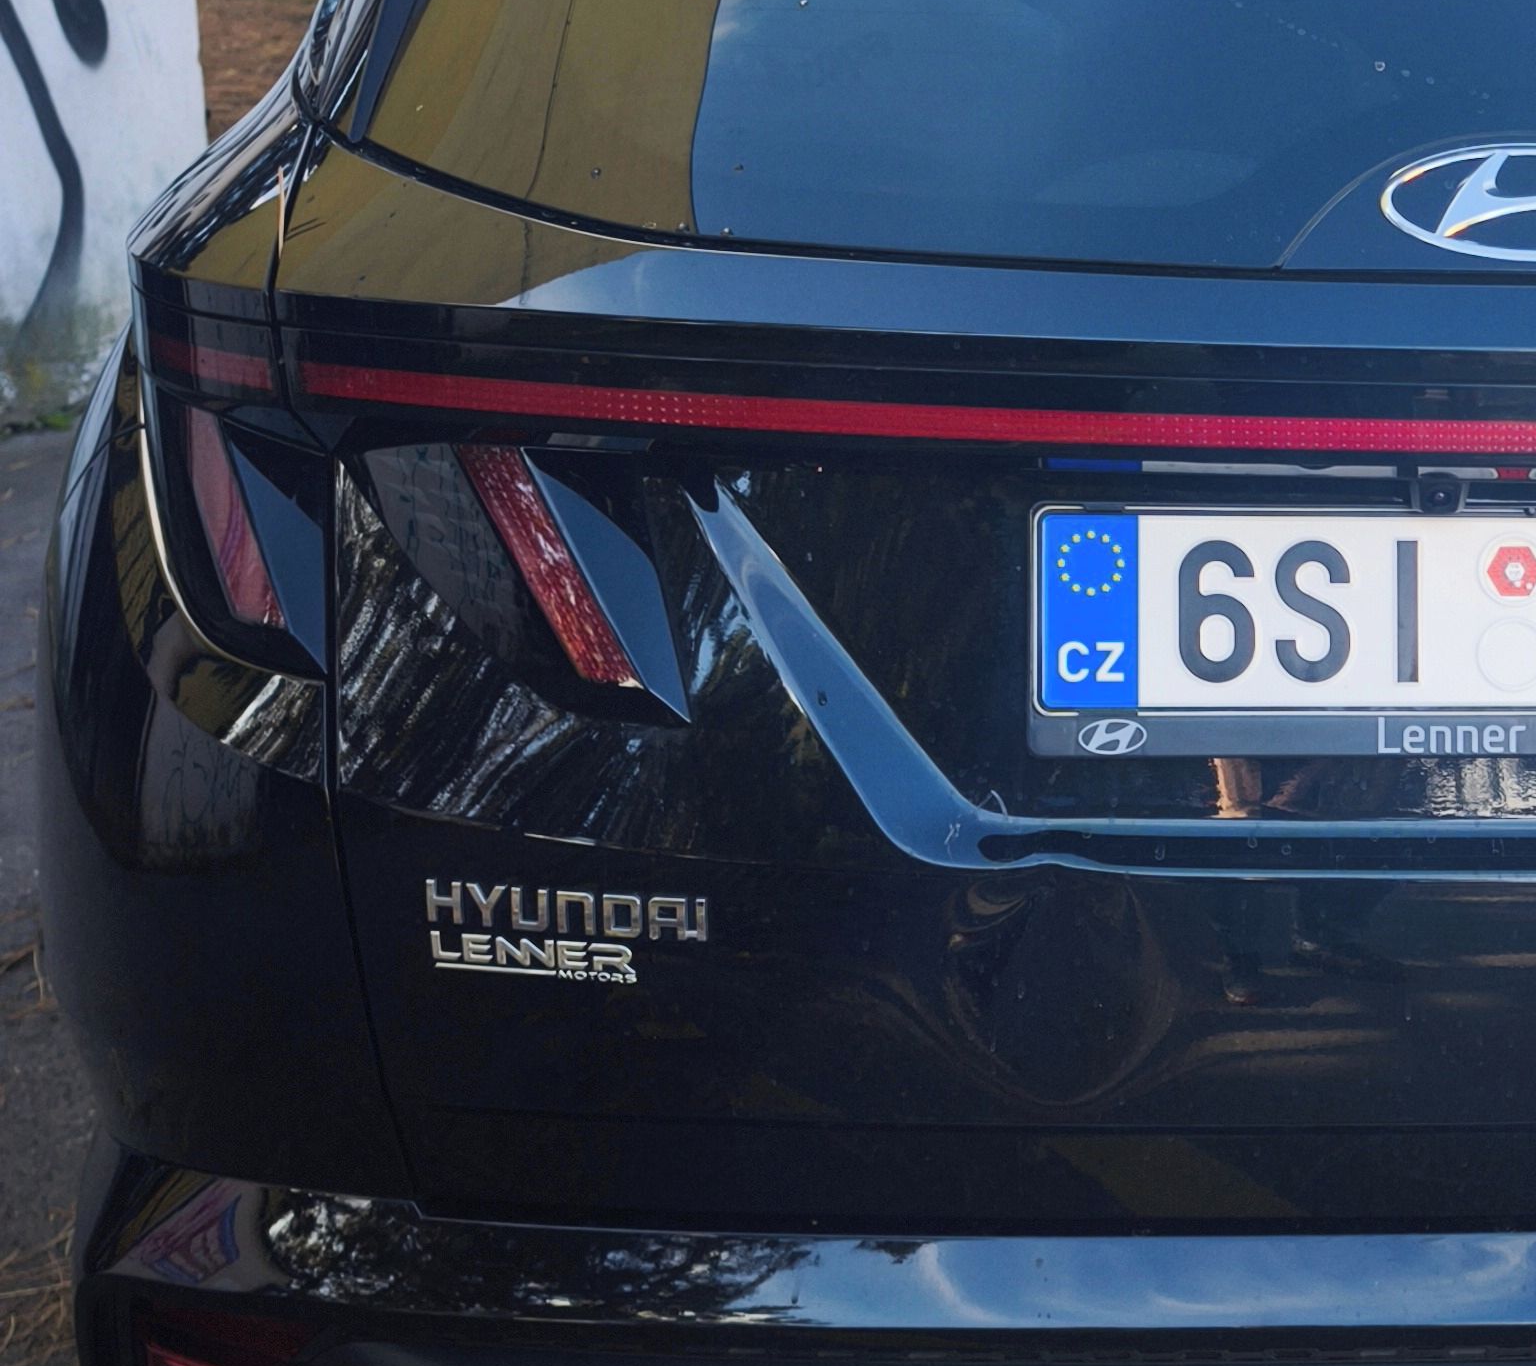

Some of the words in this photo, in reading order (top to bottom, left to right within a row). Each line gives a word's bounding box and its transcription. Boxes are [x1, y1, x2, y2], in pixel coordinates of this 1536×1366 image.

[1177, 540, 1419, 683] 6SI
[1057, 641, 1126, 683] CZ
[1377, 716, 1525, 755] Lenner
[425, 878, 708, 941] HYUNDAI
[430, 930, 636, 974] LENNER
[557, 968, 637, 984] MOTORS
